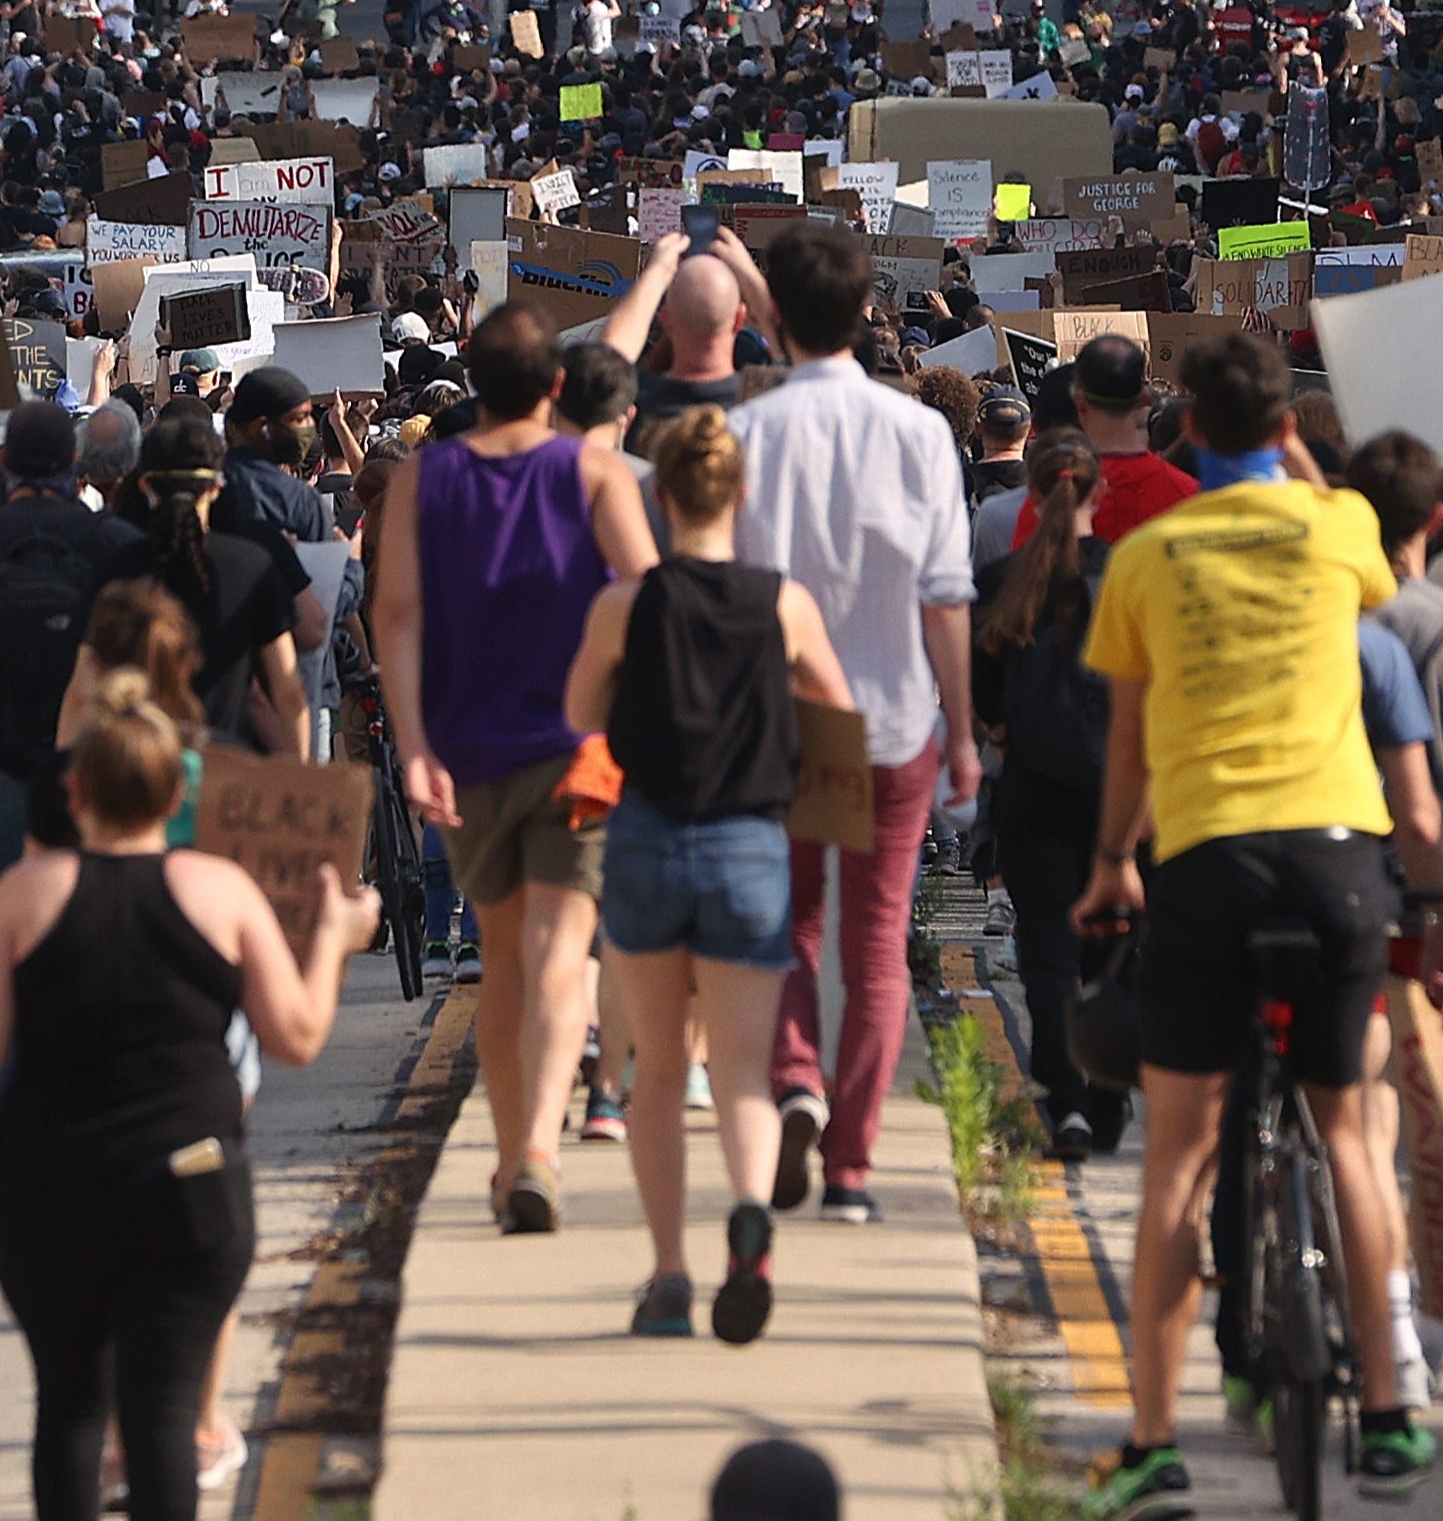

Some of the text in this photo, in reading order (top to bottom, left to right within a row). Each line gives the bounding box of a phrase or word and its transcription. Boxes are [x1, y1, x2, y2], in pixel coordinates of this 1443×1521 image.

[207, 167, 230, 198] I
[276, 161, 329, 190] NOT
[933, 170, 980, 185] Silence
[947, 187, 964, 203] IS
[1078, 181, 1156, 199] JUSTICE FOR
[1093, 197, 1140, 212] GEORGE
[90, 224, 176, 239] WE PAY YOUR
[196, 205, 324, 244] DEMILITARIZE
[1016, 219, 1101, 242] WHO DO
[111, 238, 167, 251] SALARY
[243, 237, 268, 251] the
[91, 250, 112, 262] YOU
[163, 253, 181, 264] US
[1069, 252, 1141, 274] ENOUGH
[8, 345, 52, 367] THE
[1020, 361, 1037, 378] the
